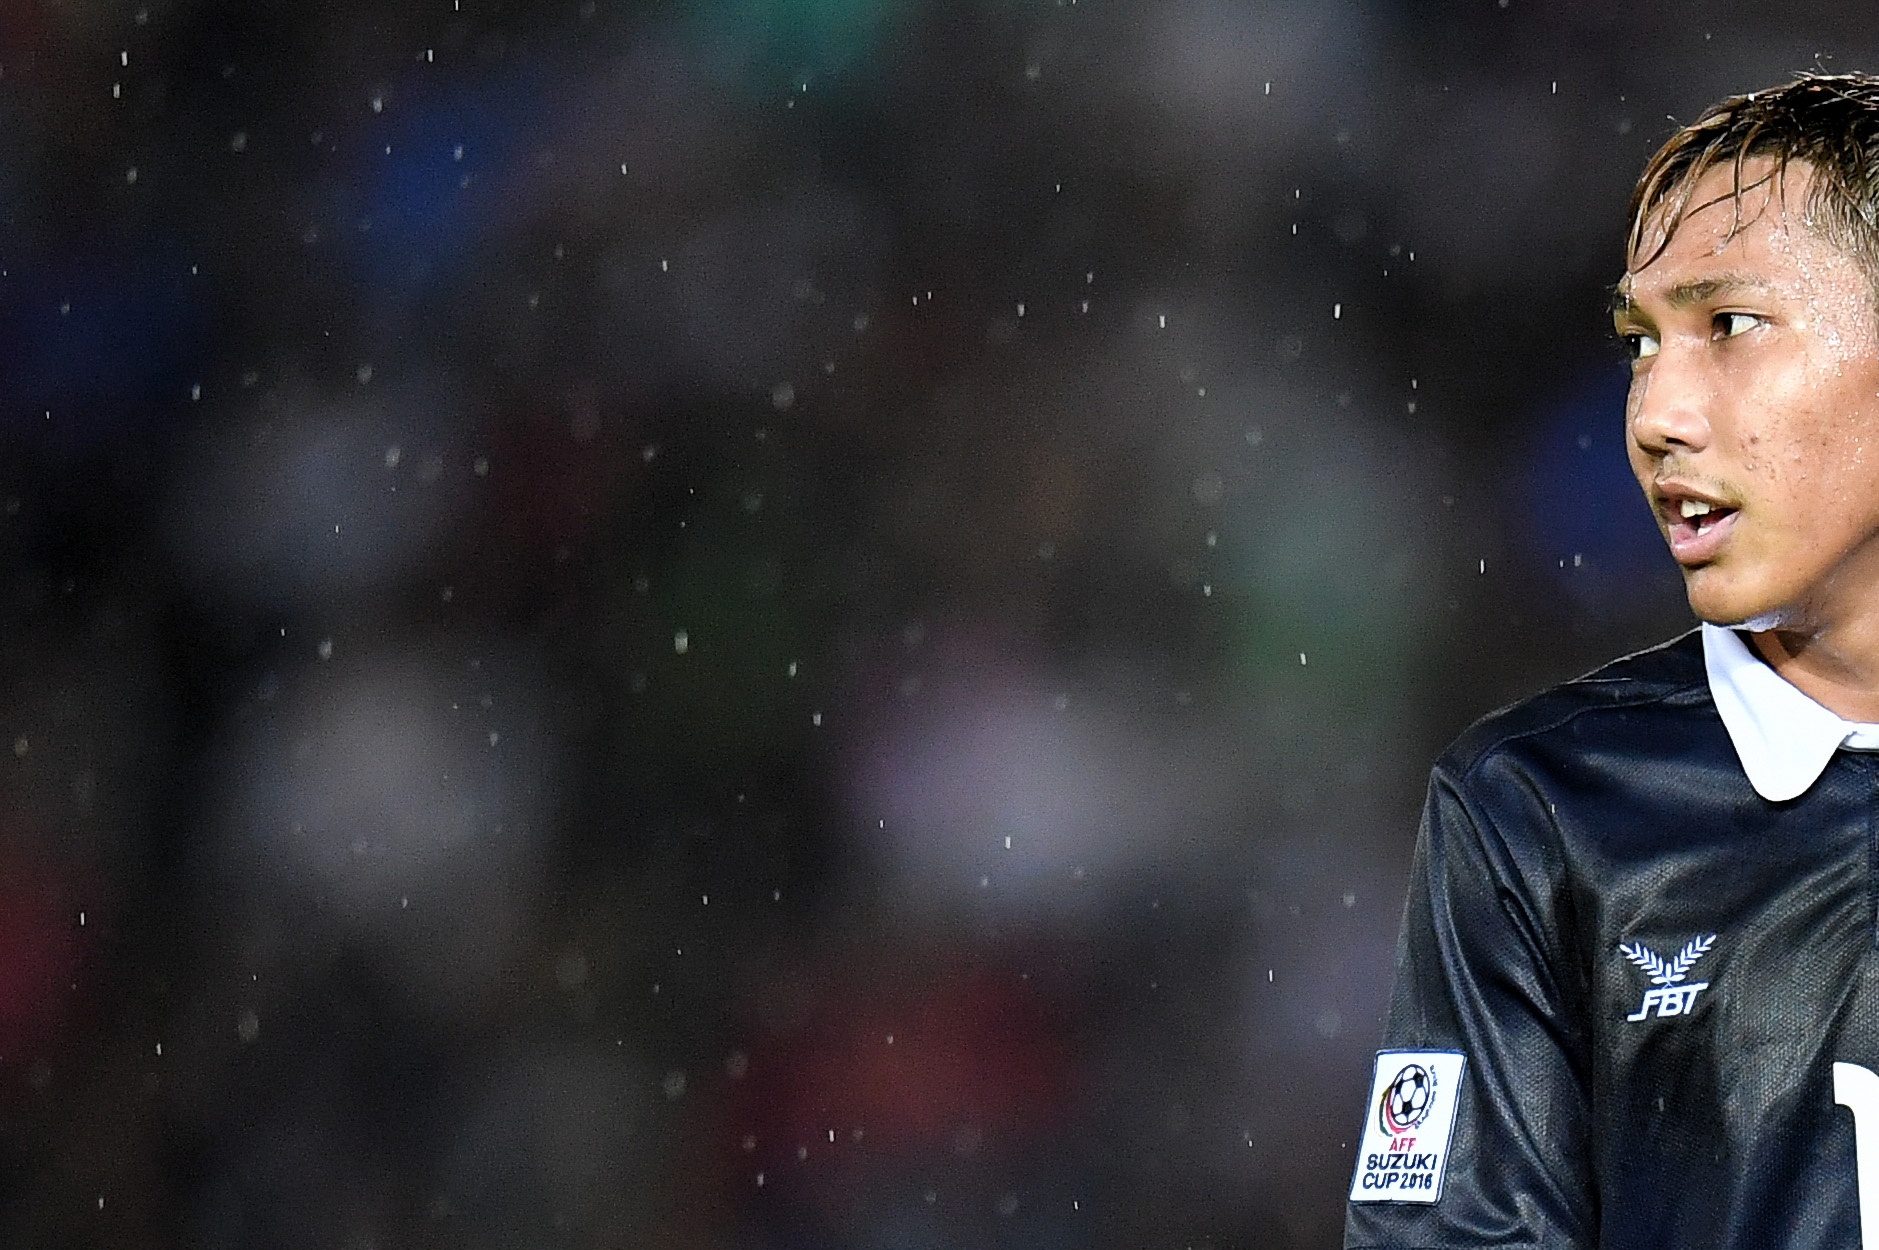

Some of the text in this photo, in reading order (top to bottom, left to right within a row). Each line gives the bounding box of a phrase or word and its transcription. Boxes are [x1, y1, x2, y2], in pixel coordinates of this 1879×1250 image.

[1627, 982, 1709, 1022] FBT
[1388, 1137, 1417, 1152] AFF
[1366, 1153, 1438, 1171] SUZUKI
[1362, 1172, 1434, 1190] CUP 2016
